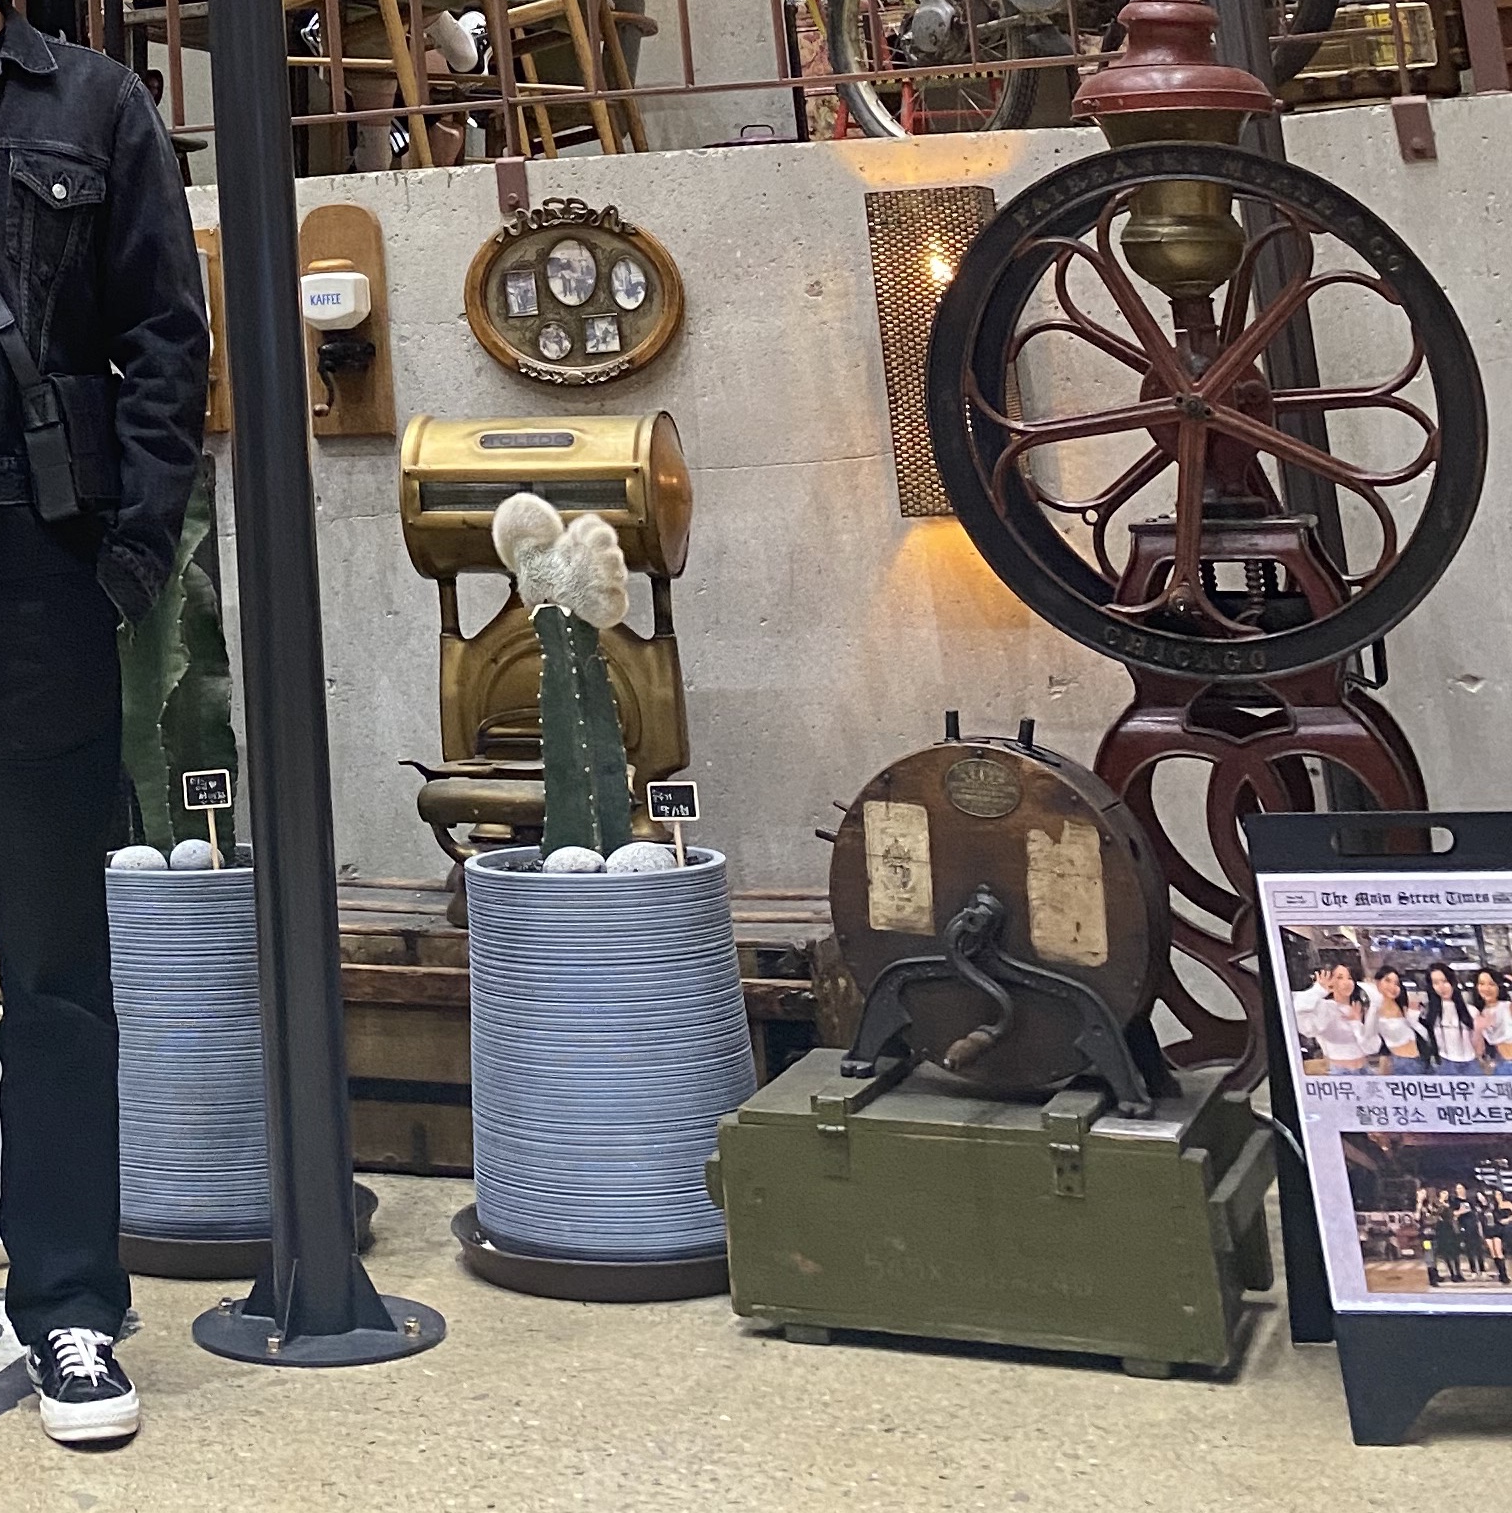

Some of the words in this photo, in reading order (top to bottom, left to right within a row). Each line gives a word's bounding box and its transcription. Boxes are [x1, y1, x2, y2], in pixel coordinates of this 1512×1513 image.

[309, 293, 342, 306] KAFFEE
[489, 434, 568, 447] TOLEDO
[1103, 625, 1267, 672] CHICAGO
[1320, 891, 1349, 908] The
[1354, 891, 1392, 907] Main
[1397, 890, 1441, 906] Street
[1445, 890, 1490, 906] Times
[1392, 1106, 1430, 1125] 장소
